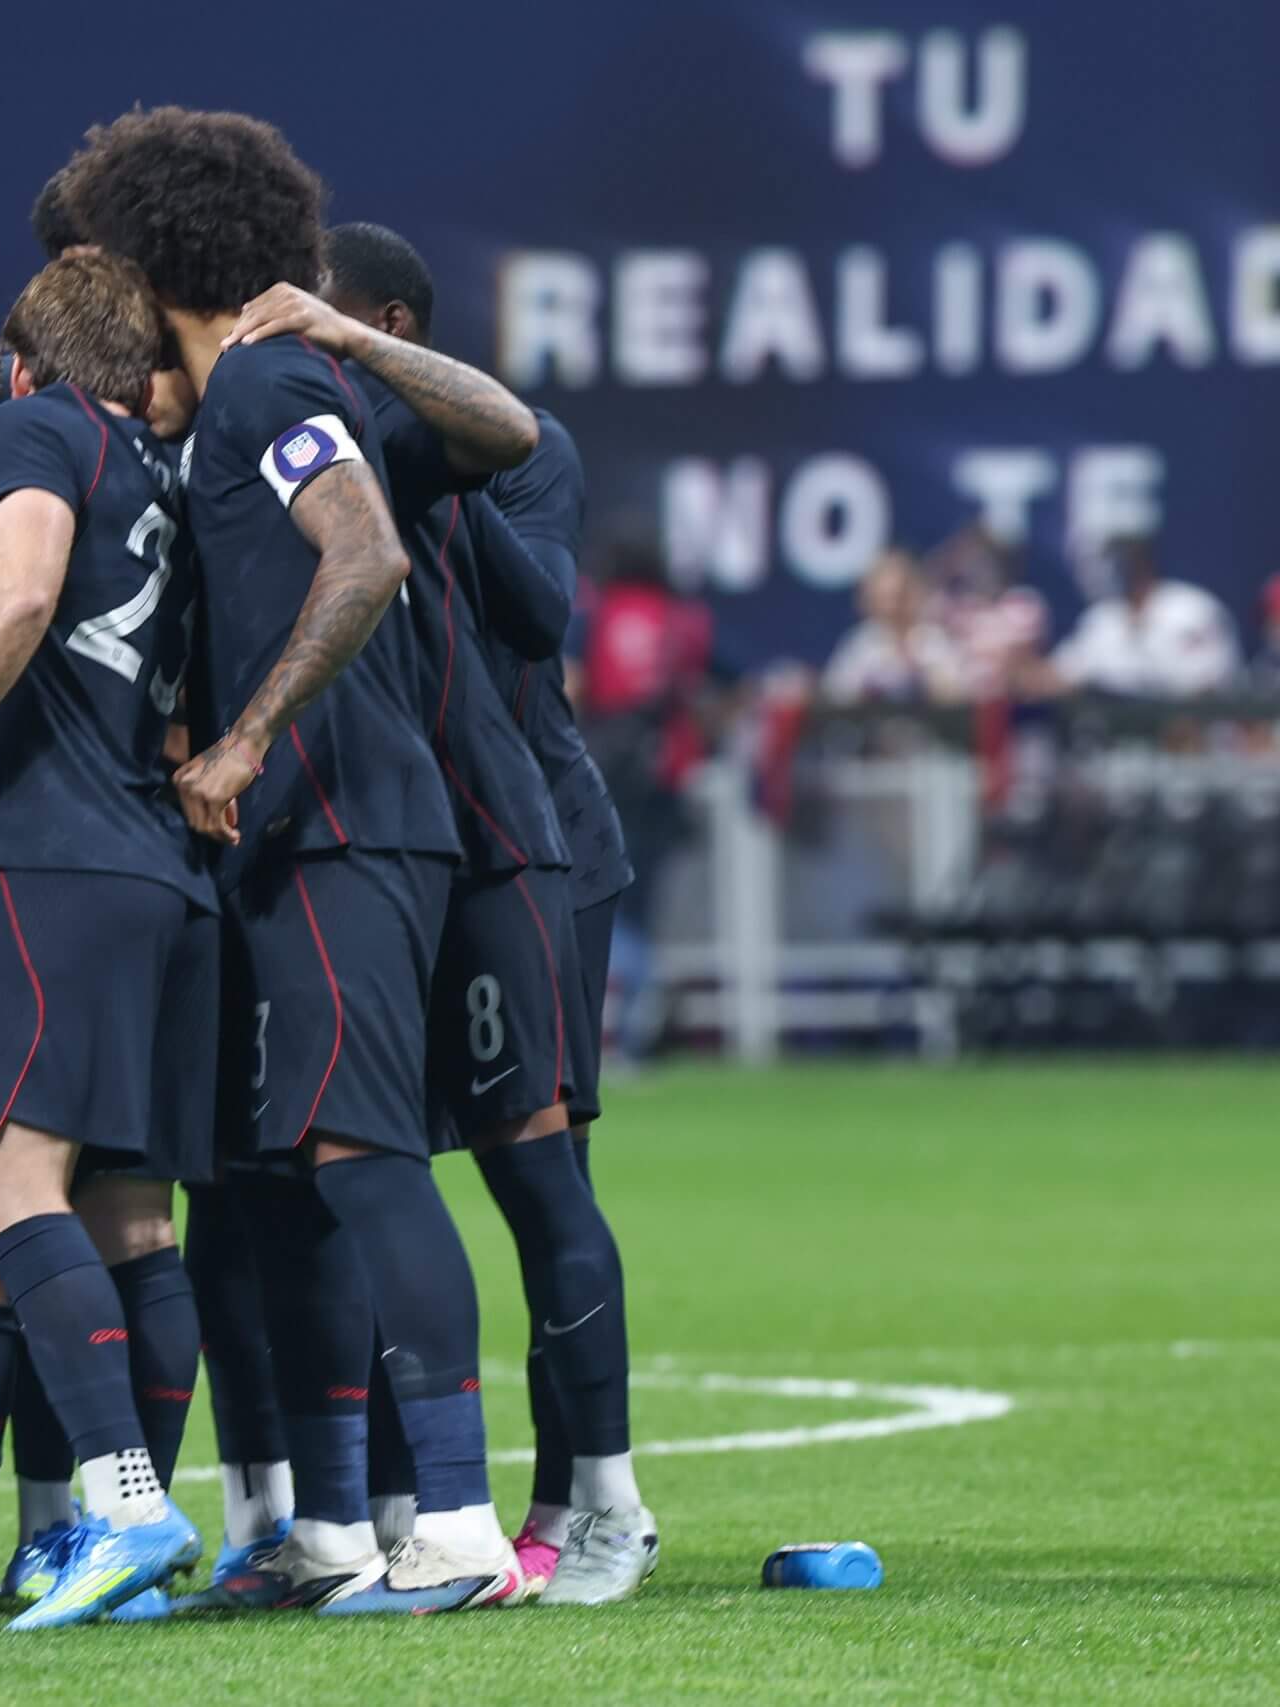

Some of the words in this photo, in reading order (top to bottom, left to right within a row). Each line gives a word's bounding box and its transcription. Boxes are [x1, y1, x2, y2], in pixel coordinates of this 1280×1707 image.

[803, 25, 1027, 168] TU
[662, 452, 892, 592] NO
[467, 974, 505, 1062] 8
